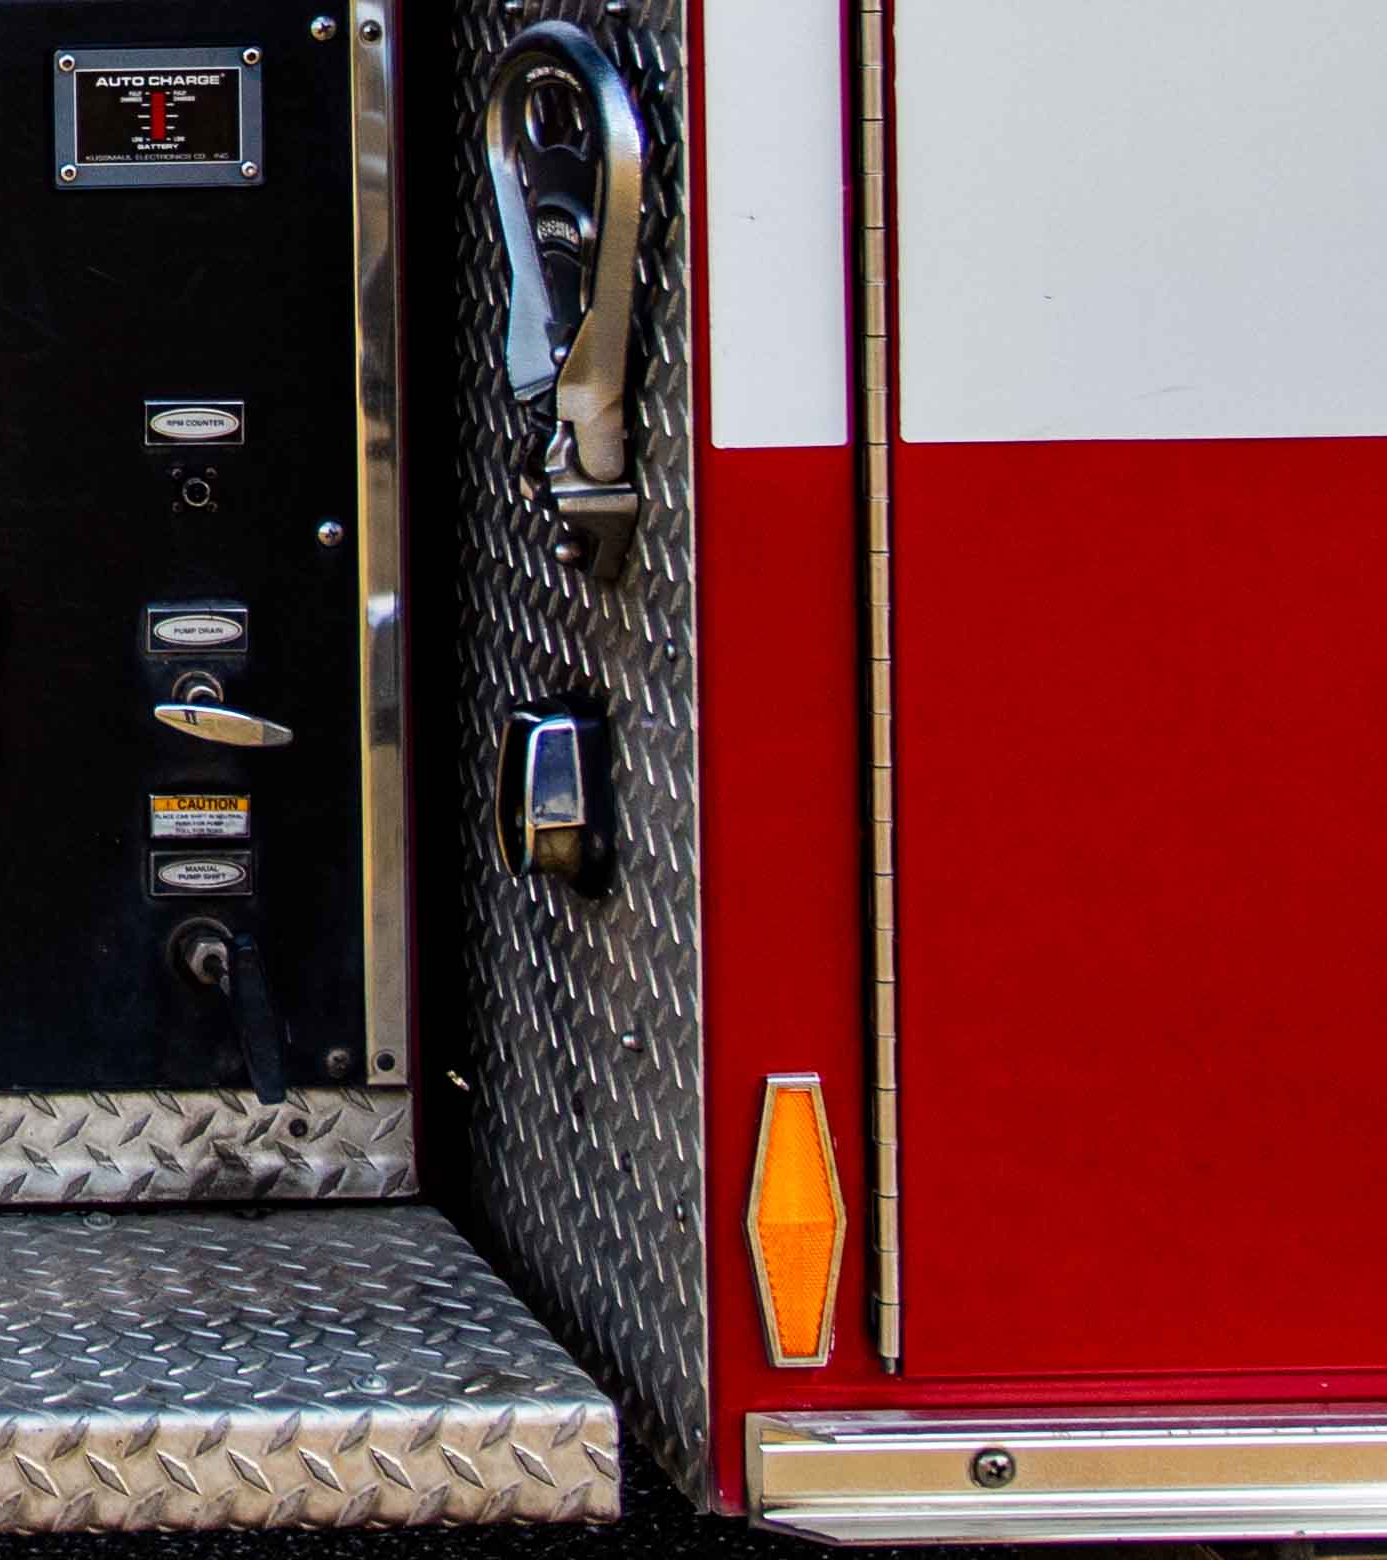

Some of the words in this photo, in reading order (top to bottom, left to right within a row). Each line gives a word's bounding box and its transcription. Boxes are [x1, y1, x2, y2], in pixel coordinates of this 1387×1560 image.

[96, 76, 144, 87] AUTO
[149, 75, 220, 86] CHARGE
[177, 799, 238, 809] CAUTION
